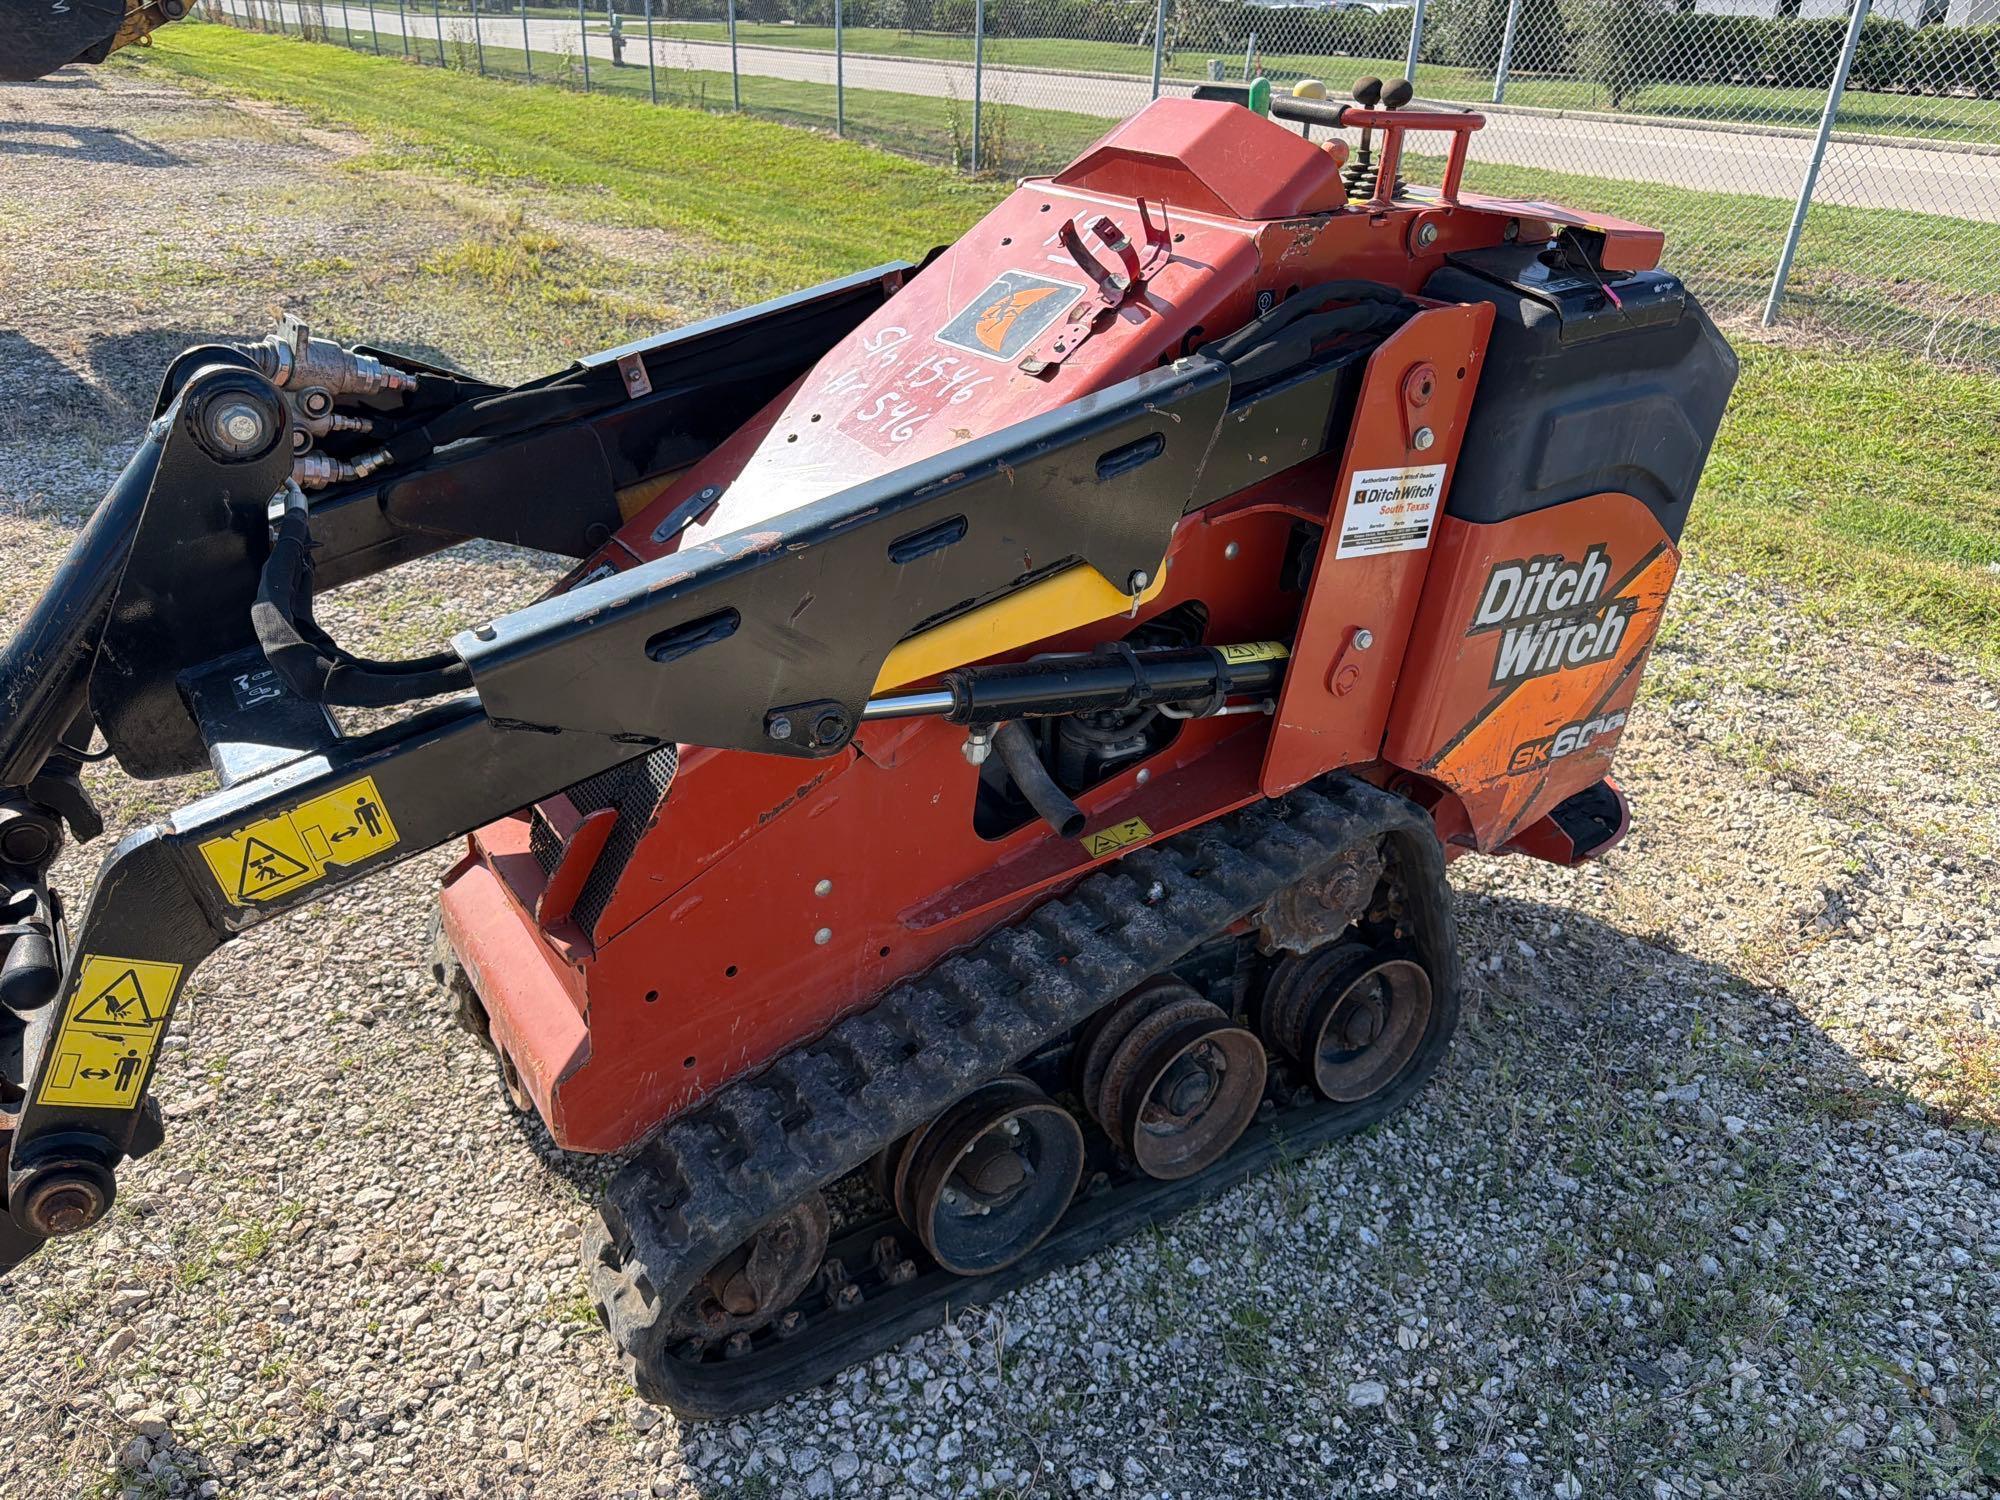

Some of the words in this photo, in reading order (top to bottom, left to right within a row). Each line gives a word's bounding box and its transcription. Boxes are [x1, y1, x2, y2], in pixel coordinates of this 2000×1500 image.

[905, 353, 994, 405] 1546
[856, 391, 931, 442] 546
[1379, 504, 1404, 515] South
[1406, 502, 1430, 512] Texas
[1474, 551, 1607, 625] Ditch
[1495, 605, 1626, 681] Witch
